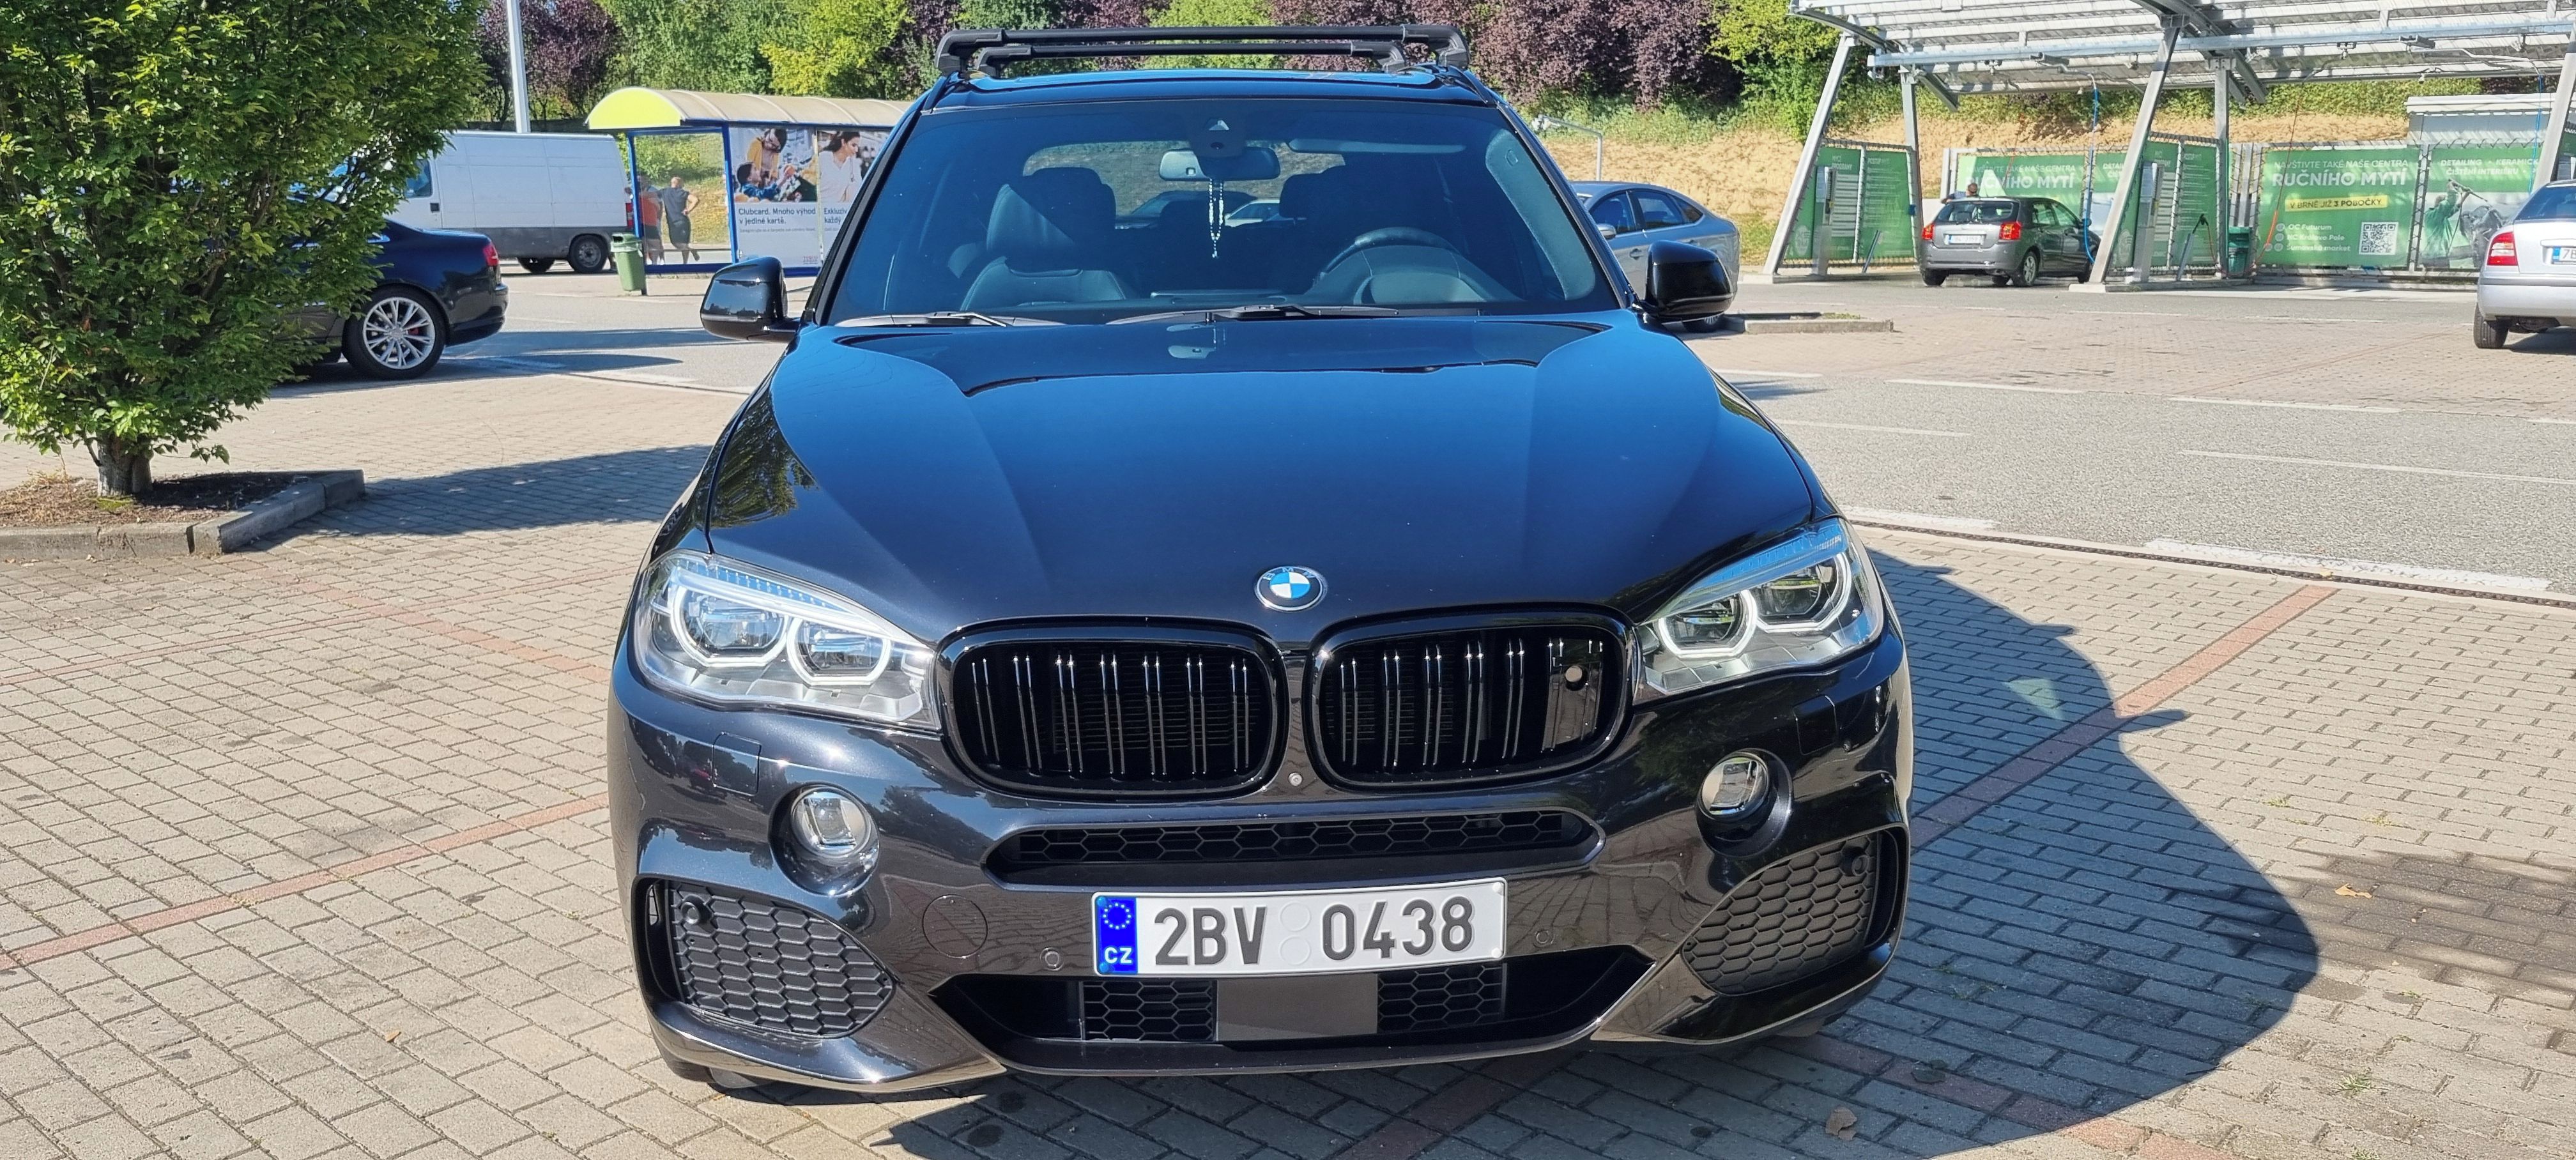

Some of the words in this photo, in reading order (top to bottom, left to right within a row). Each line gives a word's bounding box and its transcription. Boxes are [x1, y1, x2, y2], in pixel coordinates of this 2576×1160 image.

[2045, 164, 2076, 172] CENTRA
[2274, 160, 2321, 169] NAVŠTIVTE
[2323, 159, 2344, 168] TAKÉ
[2345, 159, 2369, 168] NAŠE
[2372, 159, 2409, 168] CENTRA
[2037, 172, 2075, 188] MYTÍ
[2272, 169, 2356, 187] RUČNÍHO
[2360, 168, 2408, 186] MYTÍ
[2297, 201, 2318, 209] BRNĚ
[2320, 200, 2332, 208] JIŽ
[2341, 198, 2382, 207] POBOČKY
[797, 208, 816, 216] výhod
[745, 217, 766, 225] jediné
[824, 216, 841, 225] každý
[1262, 567, 1317, 581] BMW
[1154, 906, 1267, 966] 2BV
[1322, 896, 1473, 961] 0438
[1104, 947, 1132, 964] CZ
